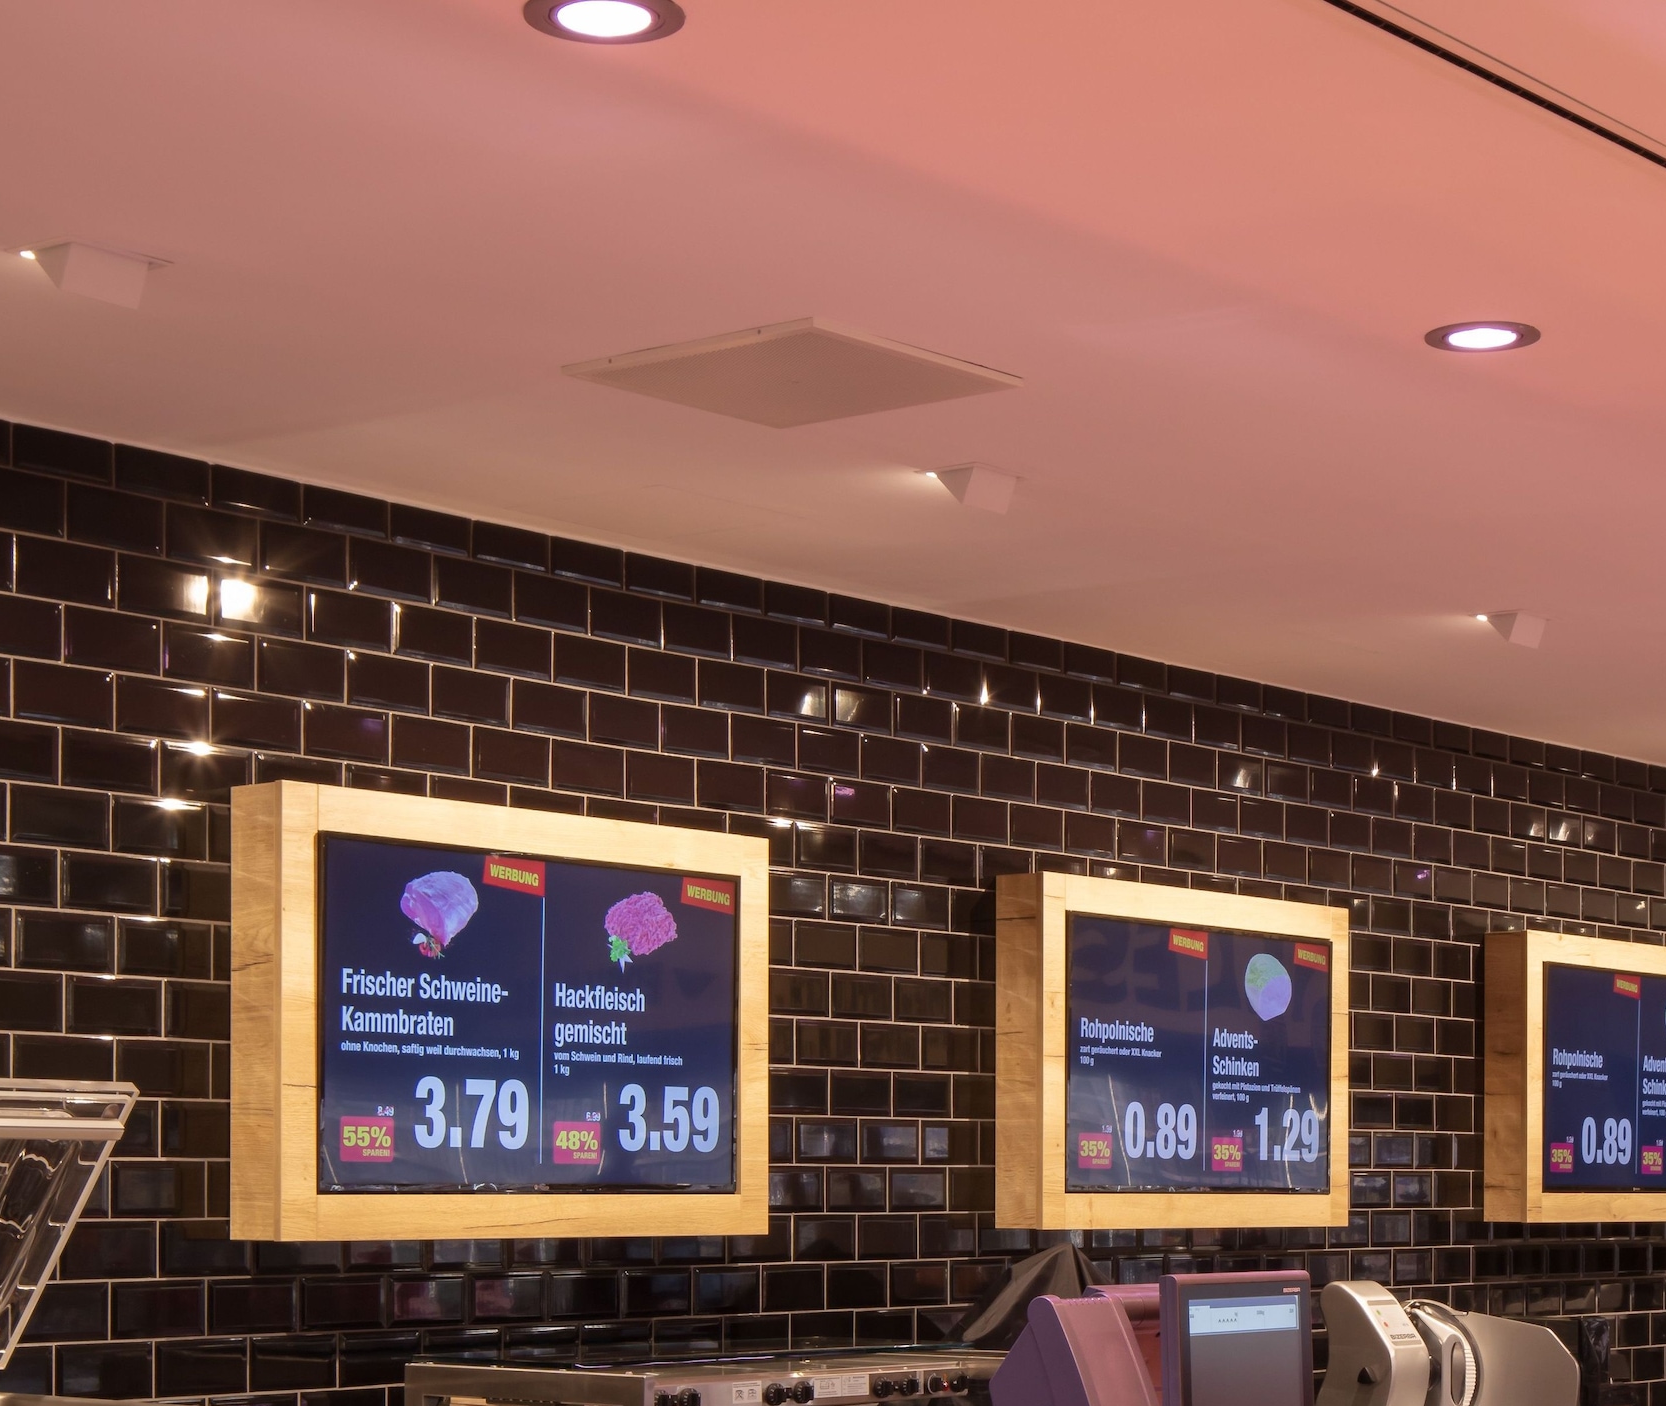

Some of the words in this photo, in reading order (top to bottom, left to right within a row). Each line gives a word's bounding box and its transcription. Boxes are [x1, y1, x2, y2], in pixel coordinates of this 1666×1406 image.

[489, 863, 539, 887] WERBUNG
[687, 884, 730, 907] WERBUNG
[1173, 934, 1204, 952] WERBUNG
[1298, 949, 1326, 966] WERBUNG
[342, 967, 415, 997] Frischer
[419, 973, 509, 1003] Schweine-
[555, 982, 646, 1012] Hackfleisch
[341, 1005, 454, 1037] Kammbraten
[1080, 1017, 1154, 1043] Rohpolnische
[554, 1020, 627, 1047] gemischt
[1213, 1028, 1258, 1050] Advents-
[341, 1040, 361, 1051] ohne
[363, 1041, 400, 1055] Knochen,
[401, 1043, 424, 1057] saftig
[426, 1045, 442, 1055] weil
[444, 1045, 501, 1060] durchwachsen,
[510, 1048, 520, 1061] kg
[554, 1052, 569, 1061] vom
[571, 1051, 601, 1063] Schwein
[603, 1053, 616, 1063] und
[618, 1053, 635, 1066] Rind,
[636, 1054, 662, 1065] laufend
[663, 1055, 683, 1066] frisch
[1553, 1048, 1603, 1070] Rohpolnische
[560, 1064, 570, 1076] kg
[1213, 1055, 1259, 1078] Schinken
[414, 1075, 529, 1150] 3.79
[619, 1083, 720, 1153] 3.59
[343, 1125, 392, 1147] 55%
[556, 1131, 598, 1150] 48%
[1125, 1101, 1197, 1160] 0.89
[1255, 1107, 1320, 1163] 1.29
[1582, 1116, 1632, 1165] 0.89
[1080, 1140, 1111, 1158] 35%
[1214, 1144, 1242, 1161] 35%
[1551, 1149, 1573, 1163] 35%
[1642, 1151, 1662, 1165] 35%
